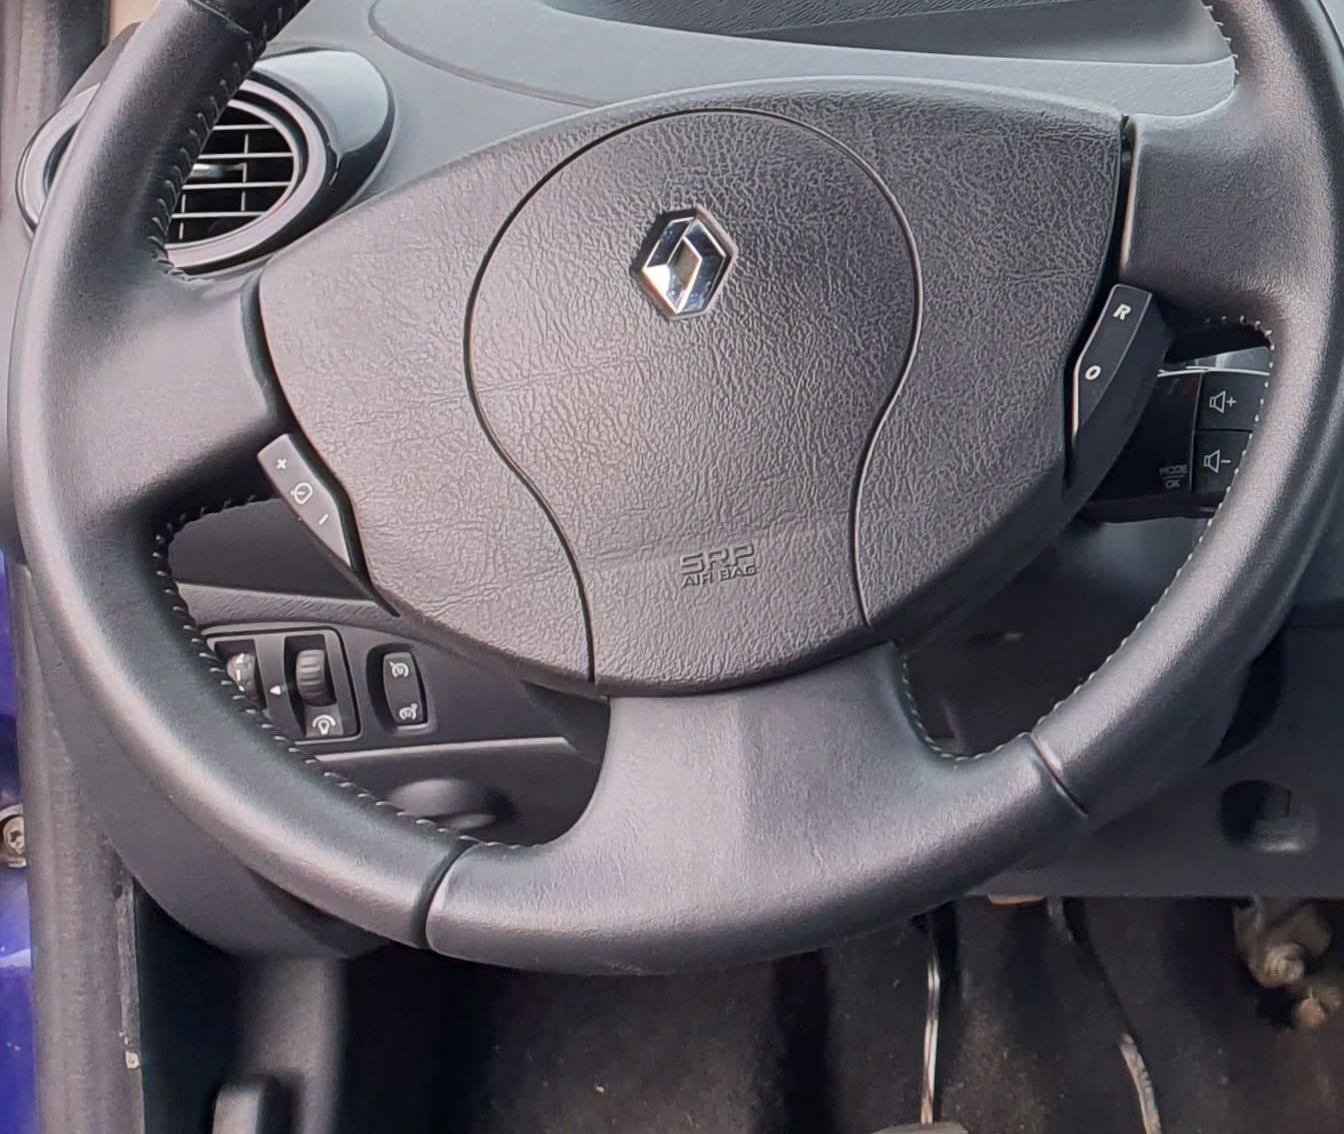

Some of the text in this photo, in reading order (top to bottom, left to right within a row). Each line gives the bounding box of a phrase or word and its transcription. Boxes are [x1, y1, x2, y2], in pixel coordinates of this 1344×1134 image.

[1113, 303, 1131, 320] R
[682, 565, 757, 588] AIR BAG
